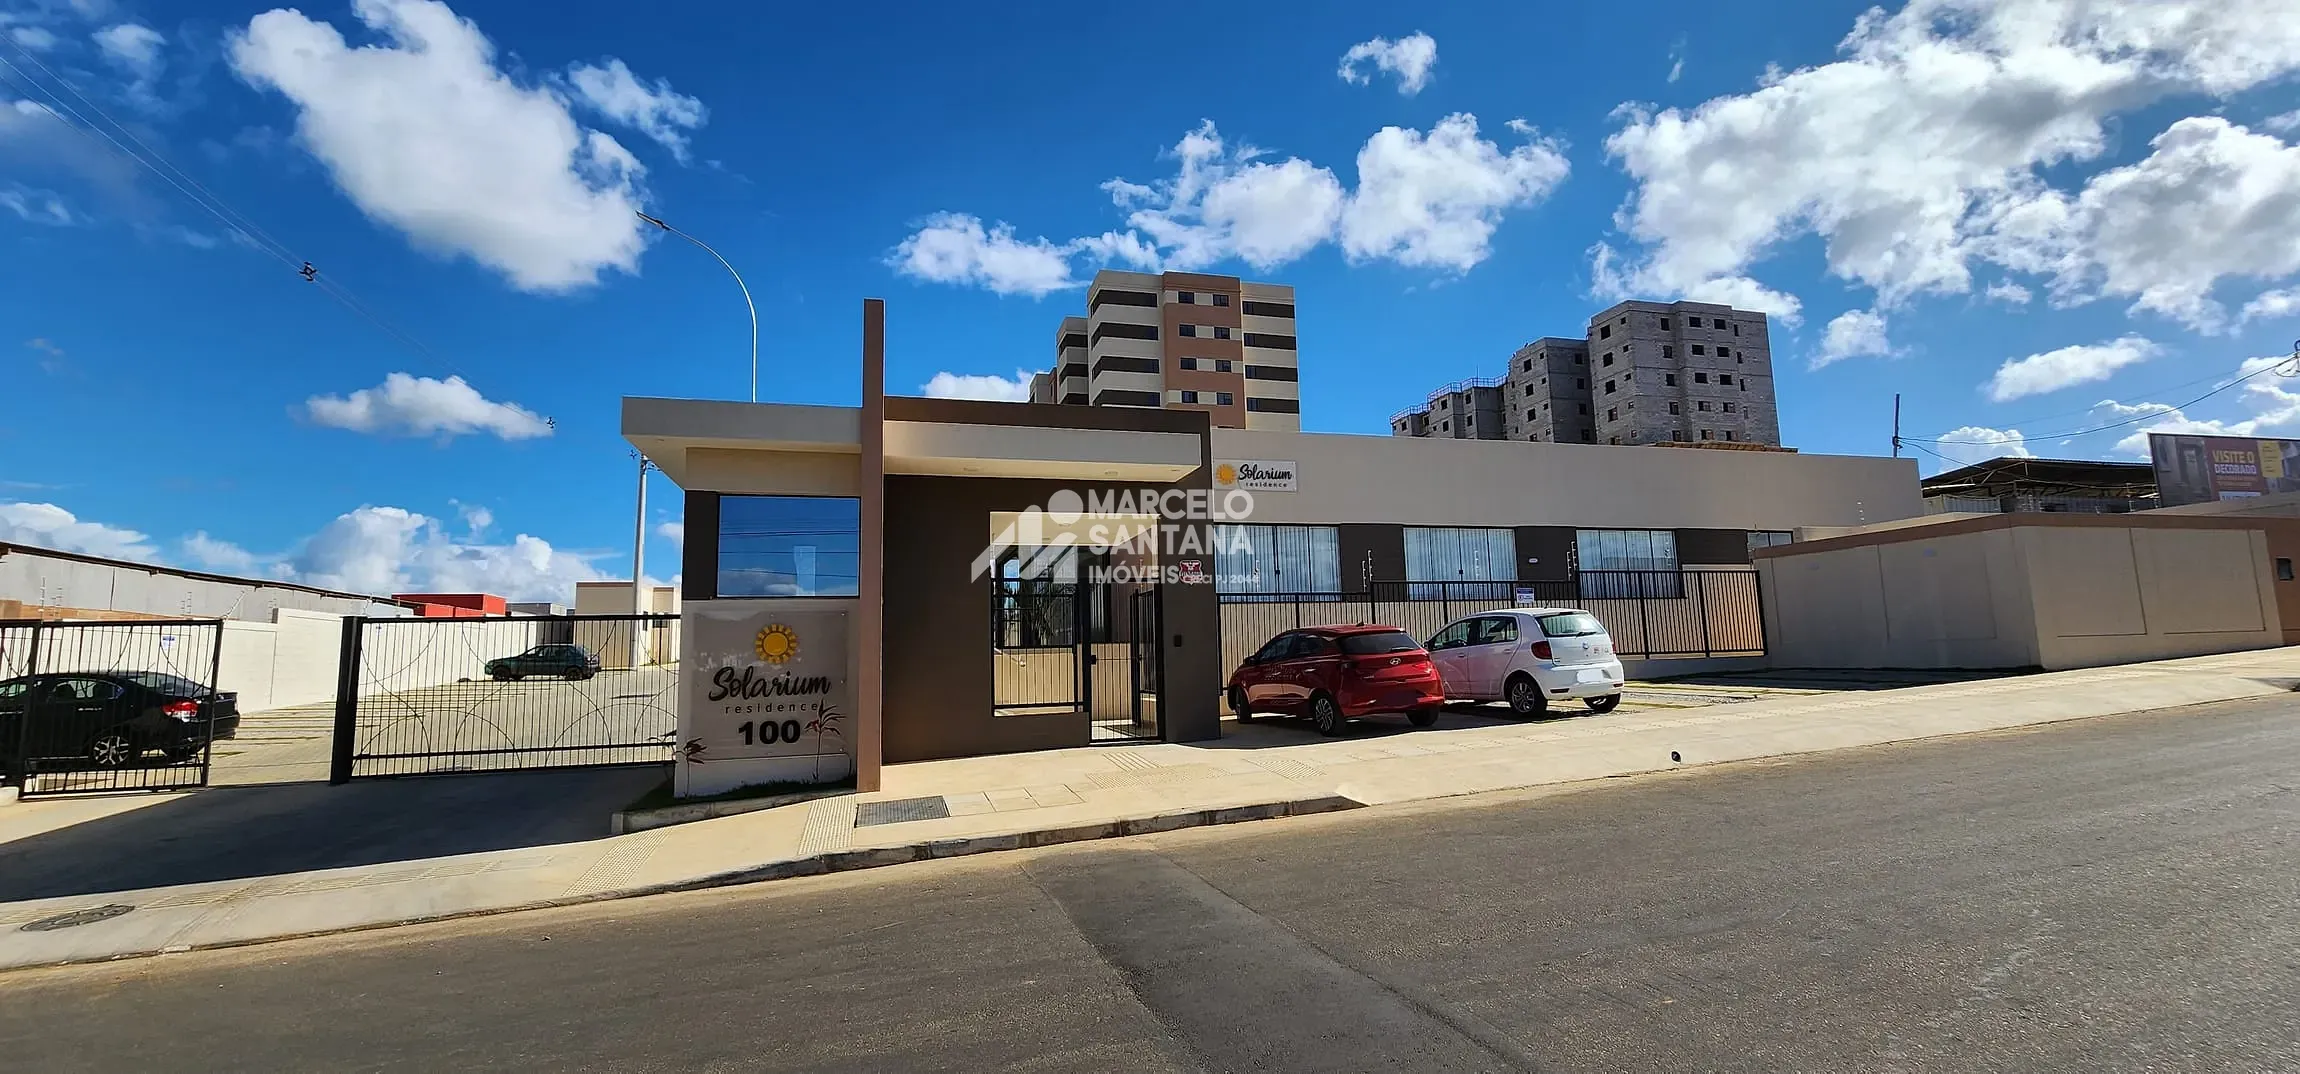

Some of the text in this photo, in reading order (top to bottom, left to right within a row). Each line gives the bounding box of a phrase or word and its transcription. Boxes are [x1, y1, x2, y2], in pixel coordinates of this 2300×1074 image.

[2212, 450, 2246, 463] VISITE
[2247, 451, 2255, 463] O
[1239, 463, 1292, 480] Solarium
[2214, 464, 2257, 474] DECORADO
[709, 666, 831, 701] Solarium
[725, 703, 818, 713] residence
[739, 720, 800, 745] 100
